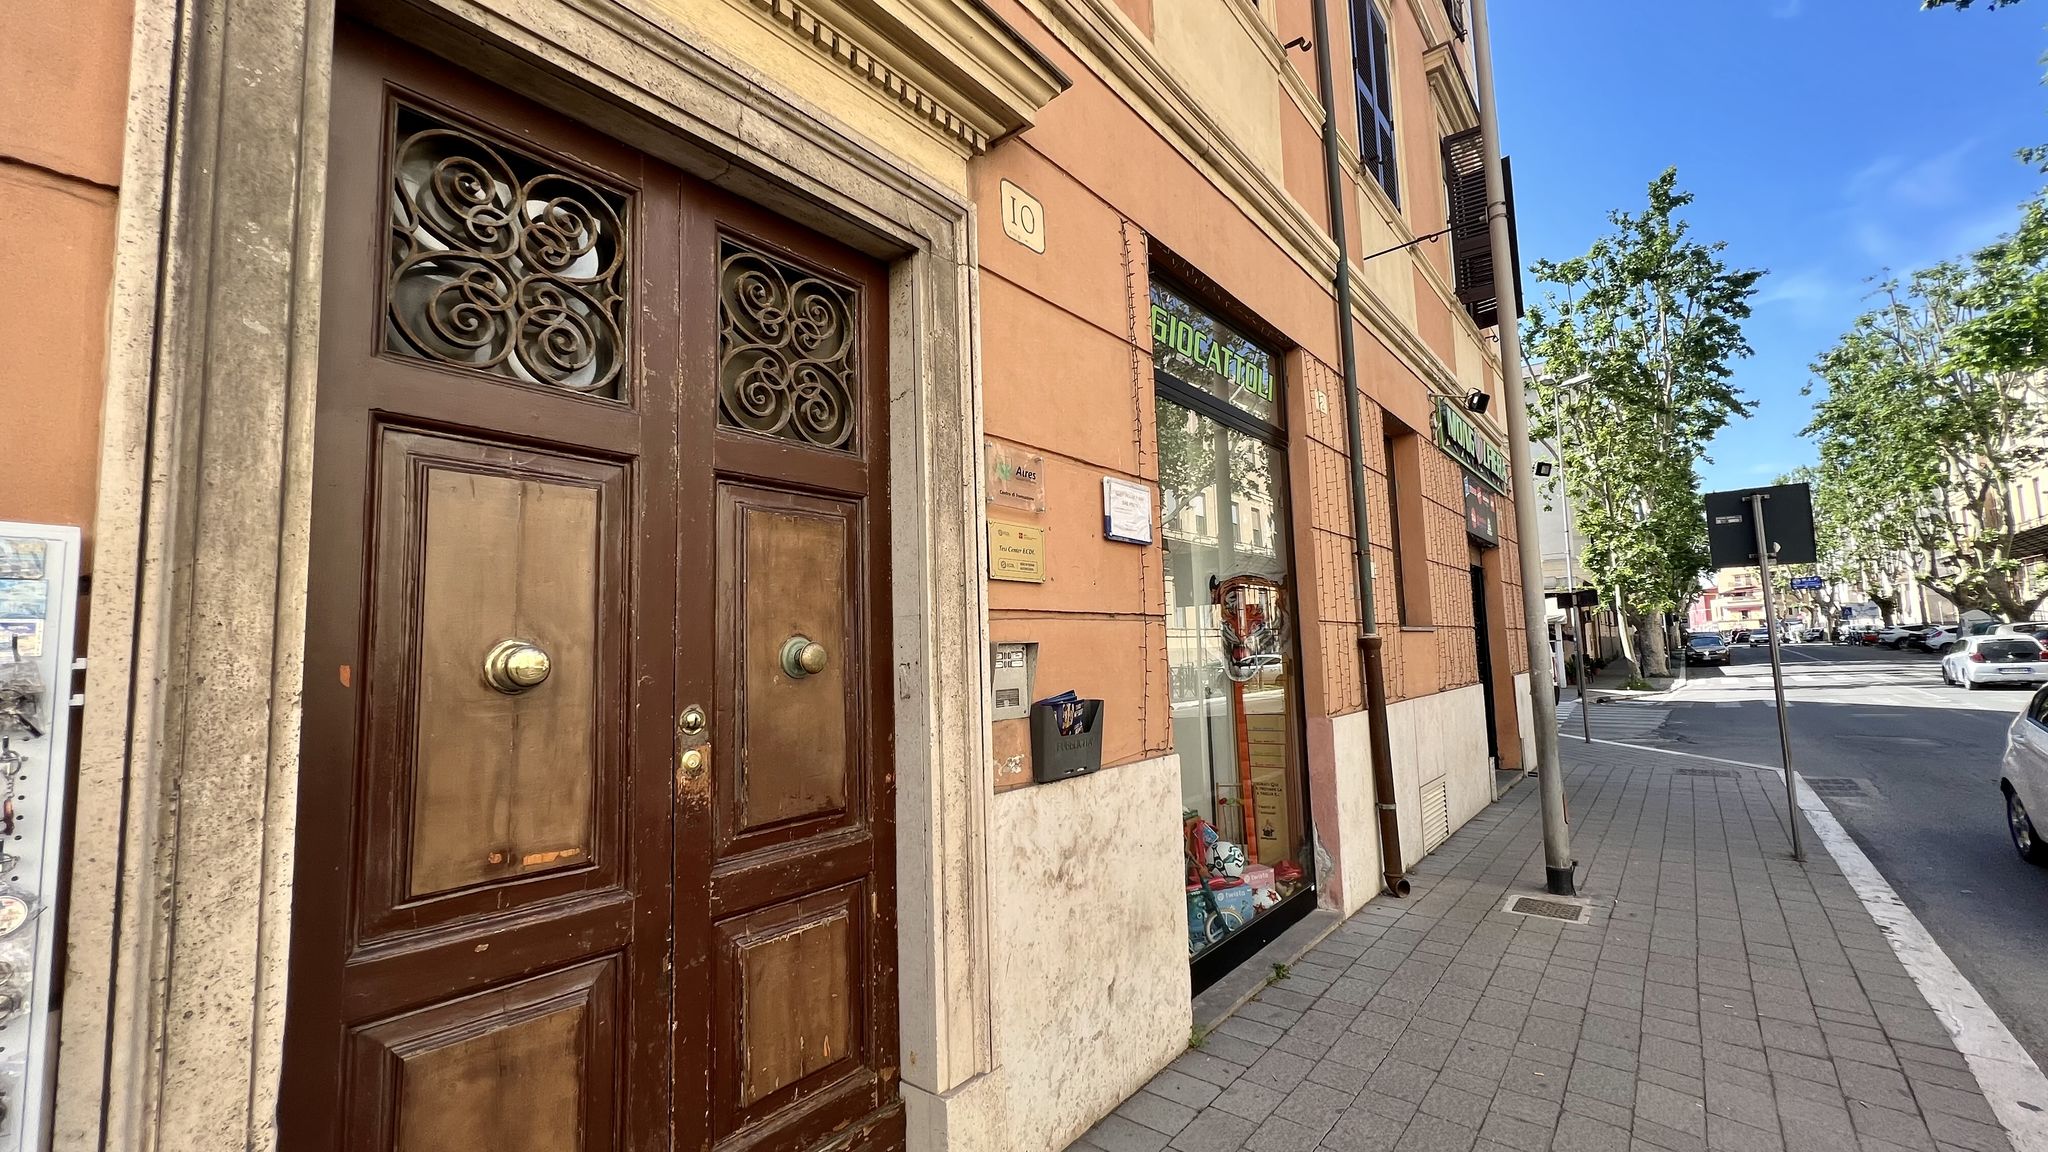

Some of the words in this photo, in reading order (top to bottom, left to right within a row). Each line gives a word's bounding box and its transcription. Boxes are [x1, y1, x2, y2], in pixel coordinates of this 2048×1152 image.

[1010, 196, 1035, 235] 10
[1151, 303, 1275, 402] GIOCATTOLI
[1015, 466, 1037, 480] Aires
[1225, 889, 1246, 899] twista
